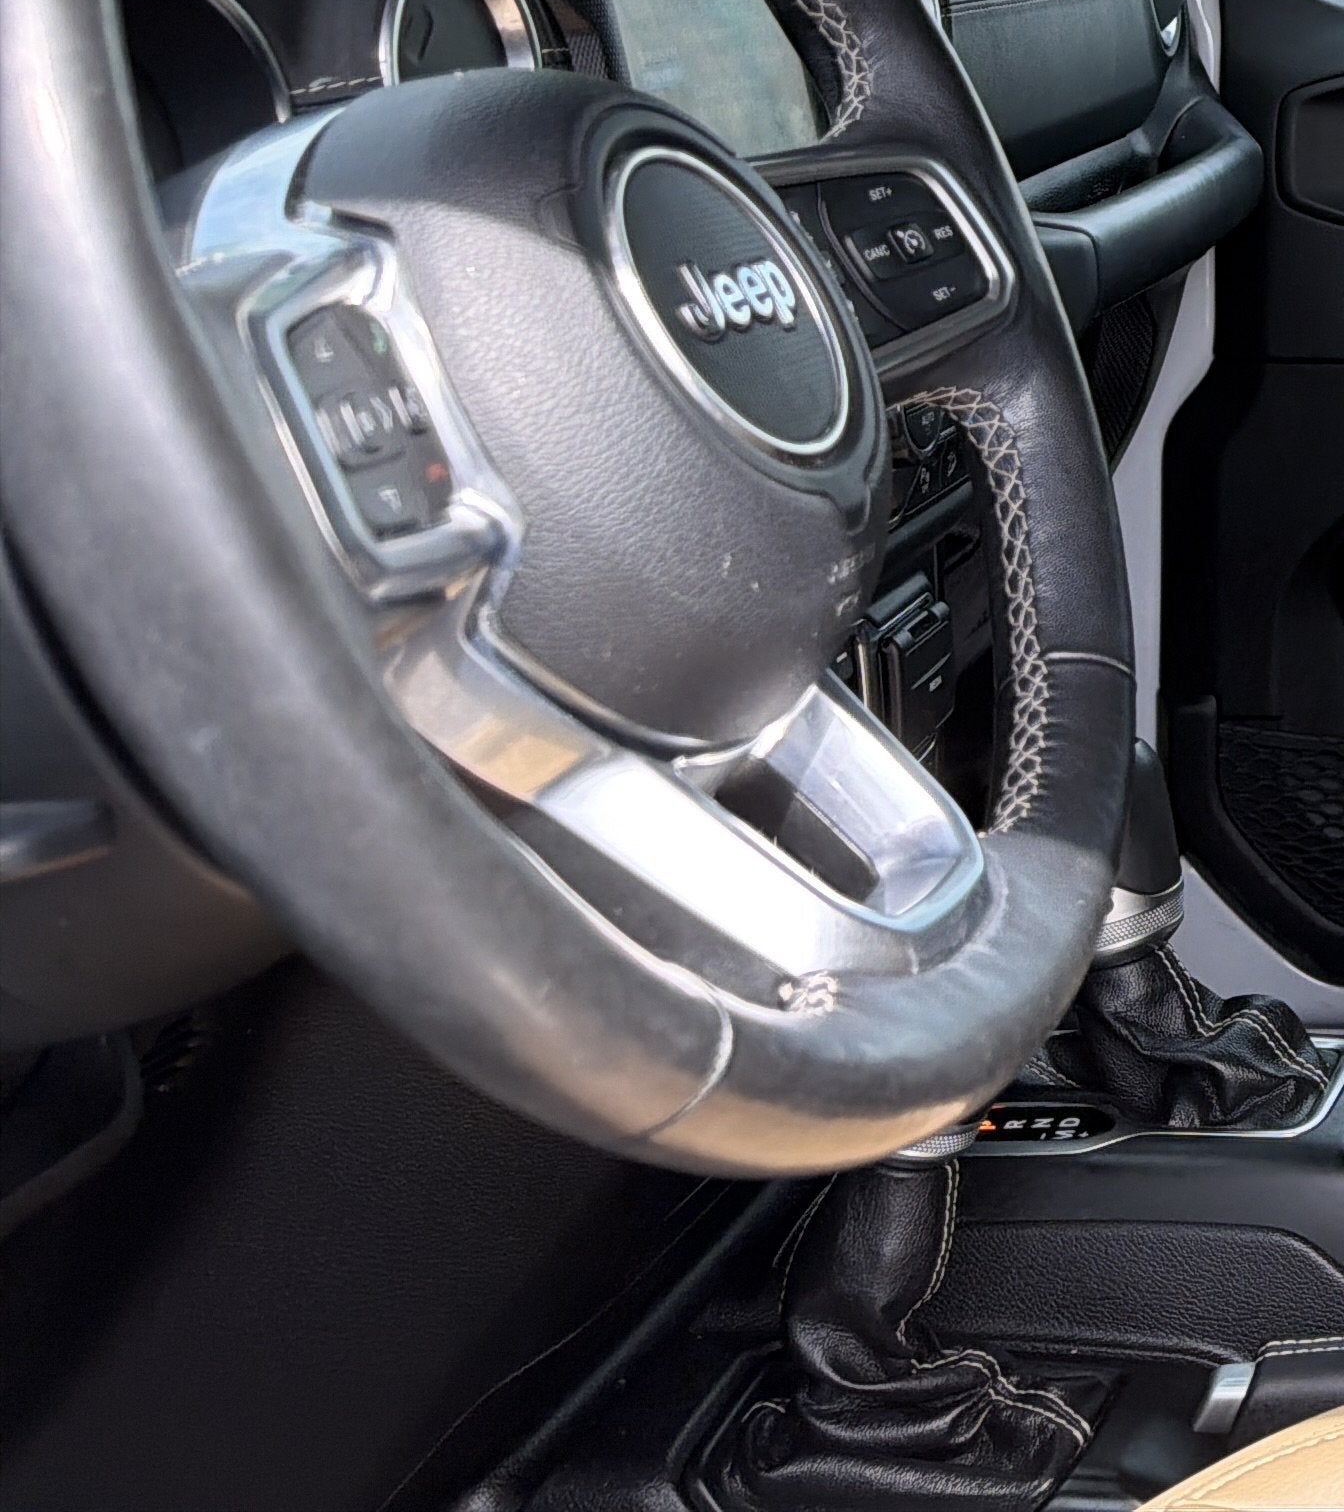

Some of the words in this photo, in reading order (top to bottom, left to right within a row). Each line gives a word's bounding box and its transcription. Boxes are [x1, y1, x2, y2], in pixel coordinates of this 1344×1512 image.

[933, 225, 954, 241] RES
[862, 244, 891, 262] CANC
[675, 260, 796, 342] Jeep
[1003, 1119, 1028, 1130] R
[1030, 1117, 1055, 1129] N
[1058, 1117, 1082, 1128] D
